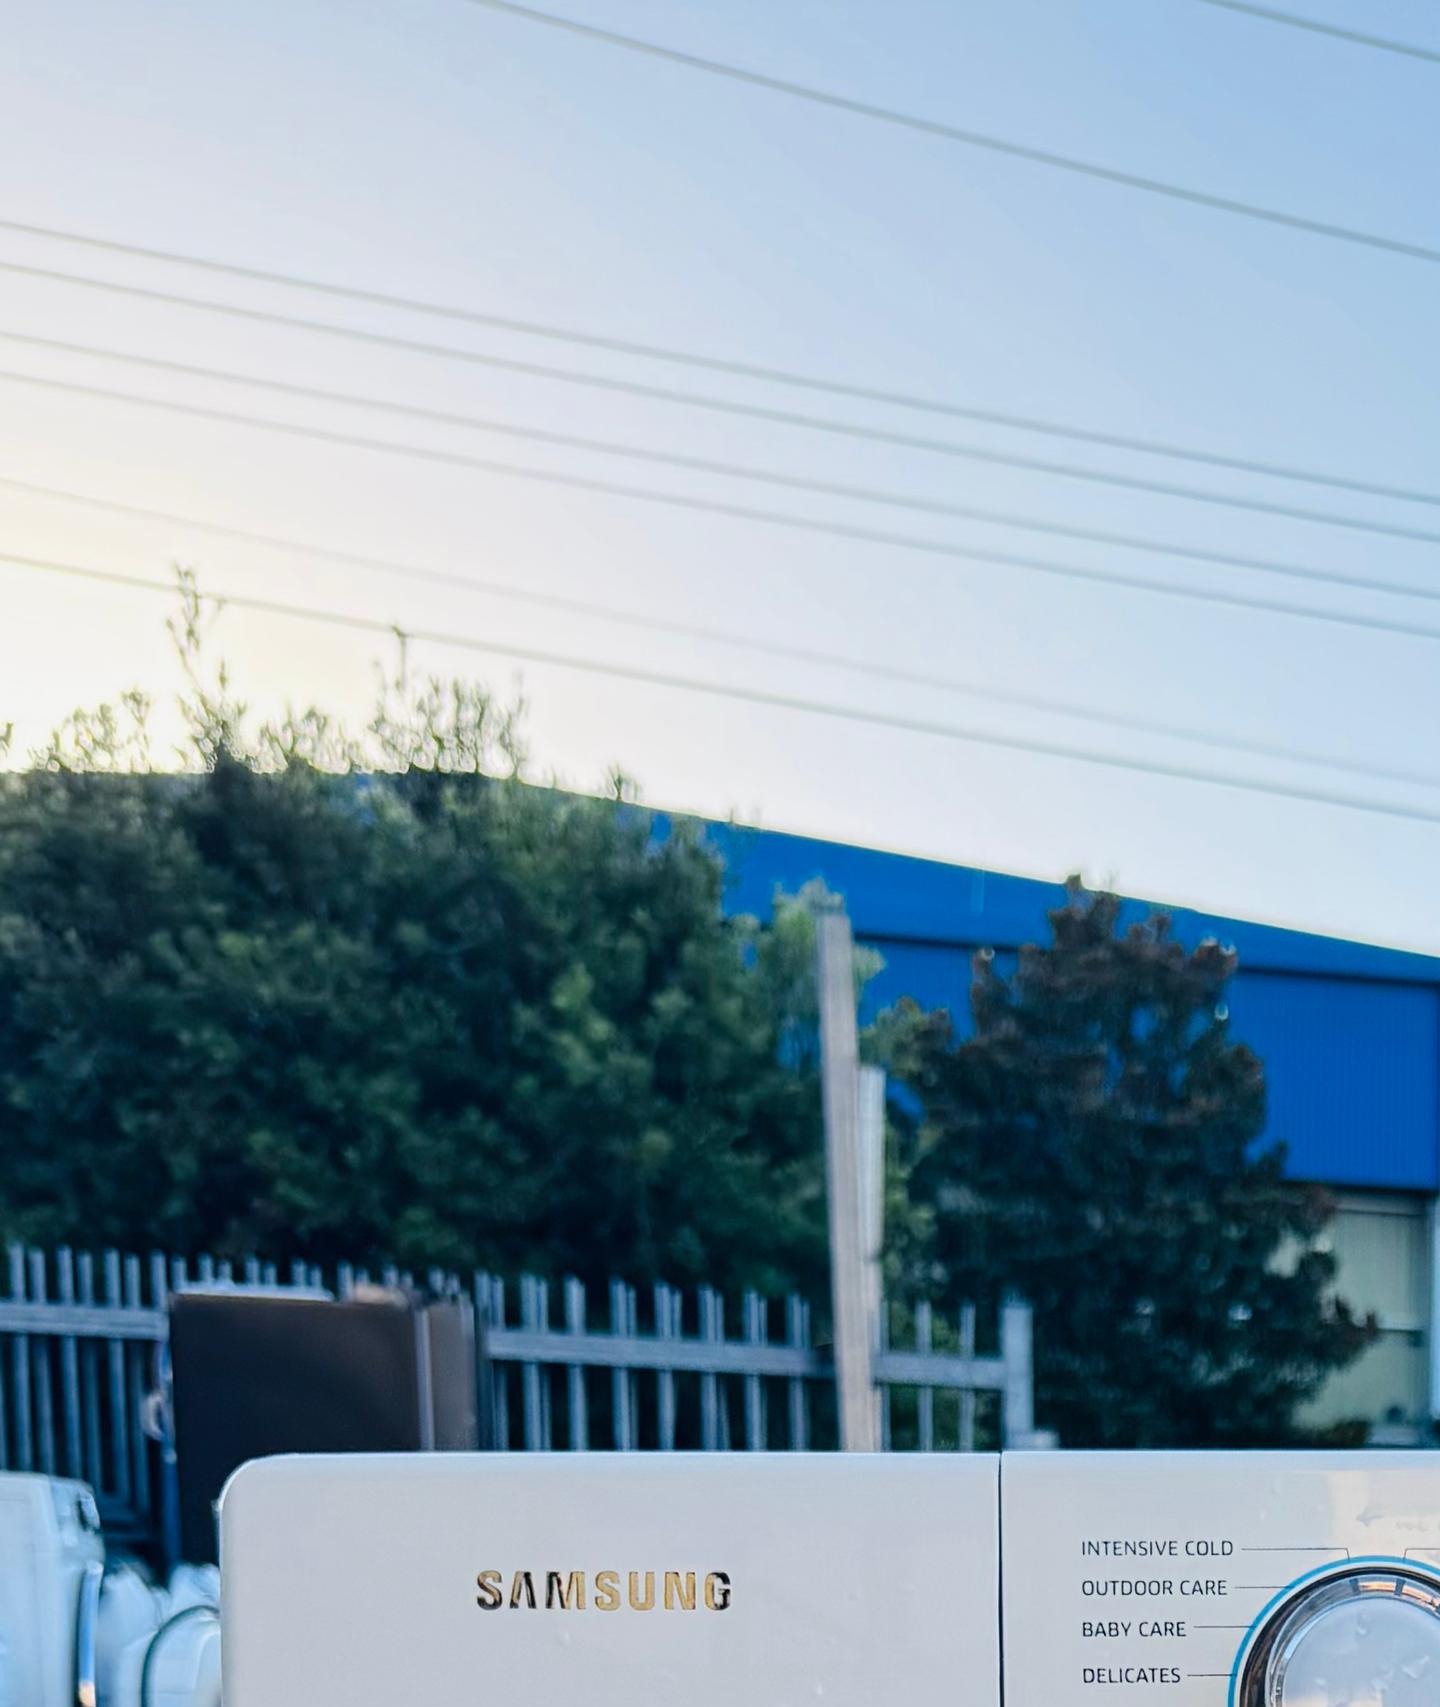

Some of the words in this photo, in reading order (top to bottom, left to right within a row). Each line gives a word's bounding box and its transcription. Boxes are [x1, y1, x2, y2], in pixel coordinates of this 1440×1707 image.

[1081, 1540, 1178, 1556] INTENSIVE
[1185, 1540, 1233, 1556] COLD
[476, 1570, 731, 1611] SAMSUNG
[1081, 1580, 1173, 1596] OUTDOOR
[1179, 1580, 1228, 1596] CARE
[1082, 1621, 1132, 1637] BABY
[1138, 1621, 1187, 1637] CARE
[1082, 1667, 1181, 1684] DELICATES
